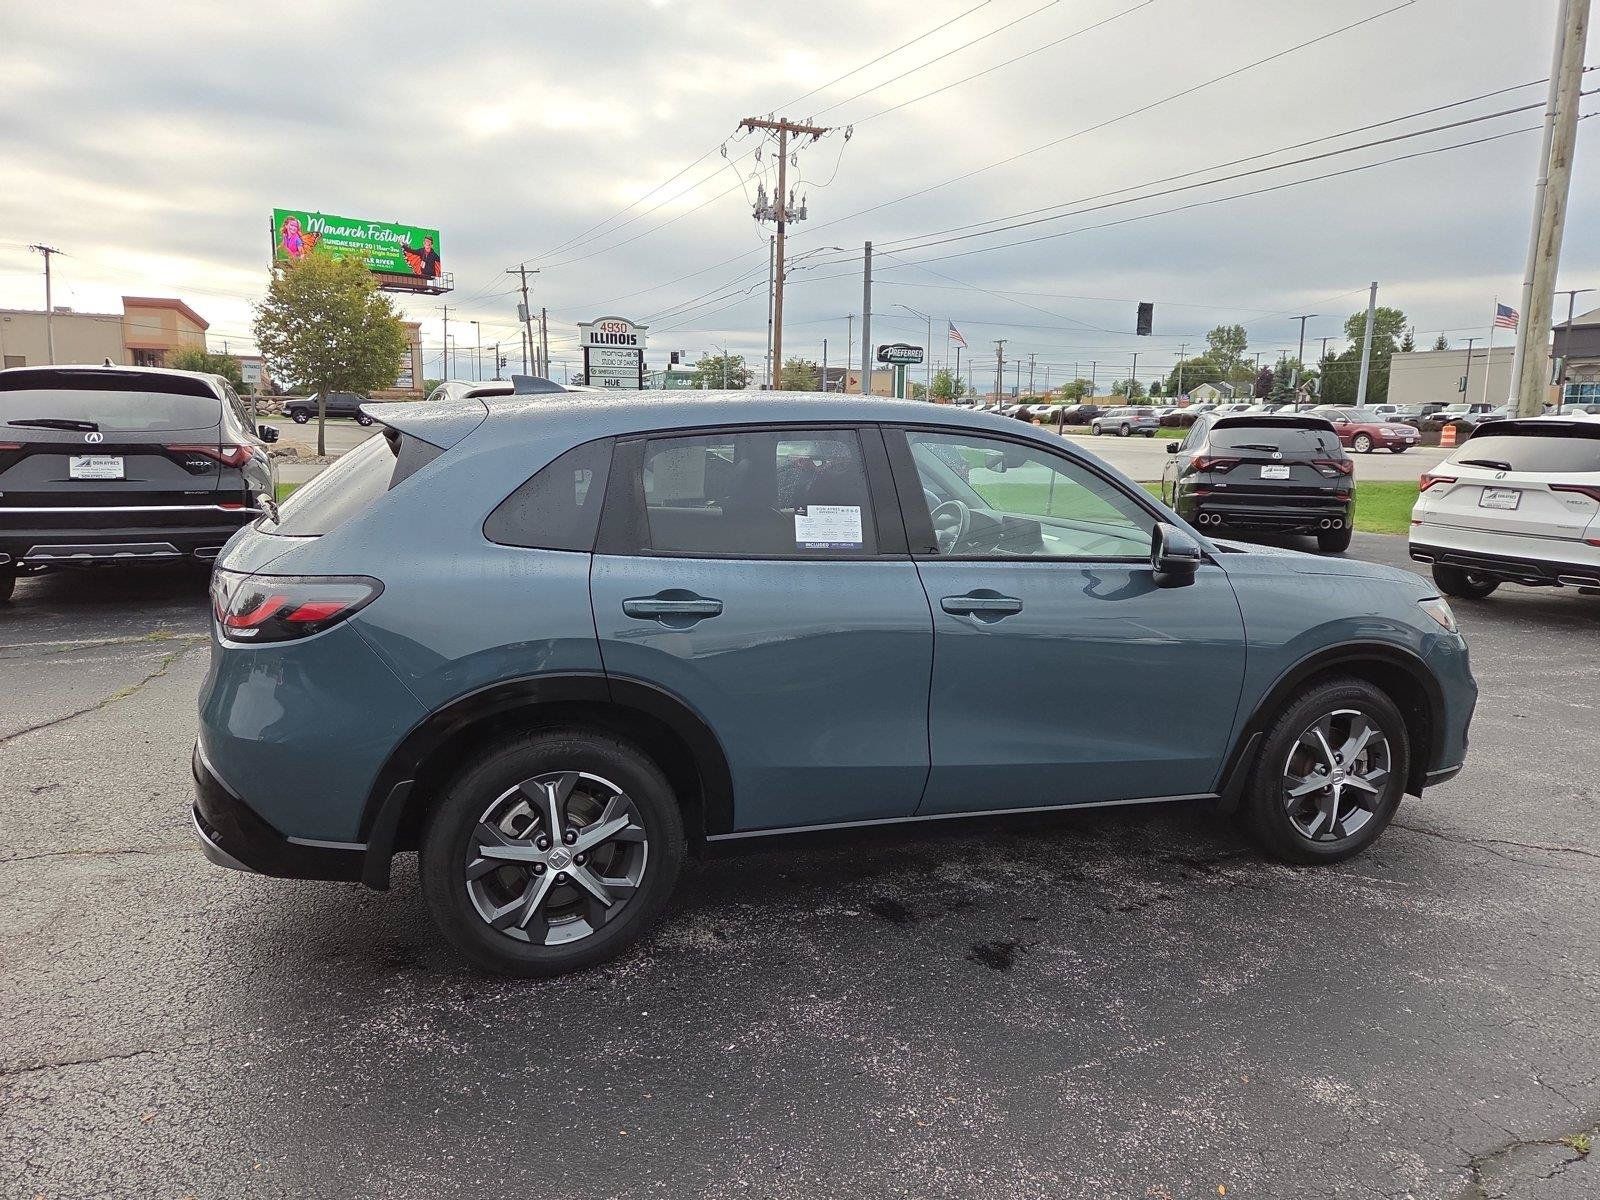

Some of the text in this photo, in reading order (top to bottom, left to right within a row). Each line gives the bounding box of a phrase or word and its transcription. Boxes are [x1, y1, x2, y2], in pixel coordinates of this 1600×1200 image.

[306, 215, 412, 245] Monarch Festival
[375, 258, 395, 266] RIVER
[600, 322, 627, 333] 4930
[590, 332, 637, 345] ILLINOIS
[887, 346, 923, 359] PREFERRED
[604, 378, 621, 386] HUE
